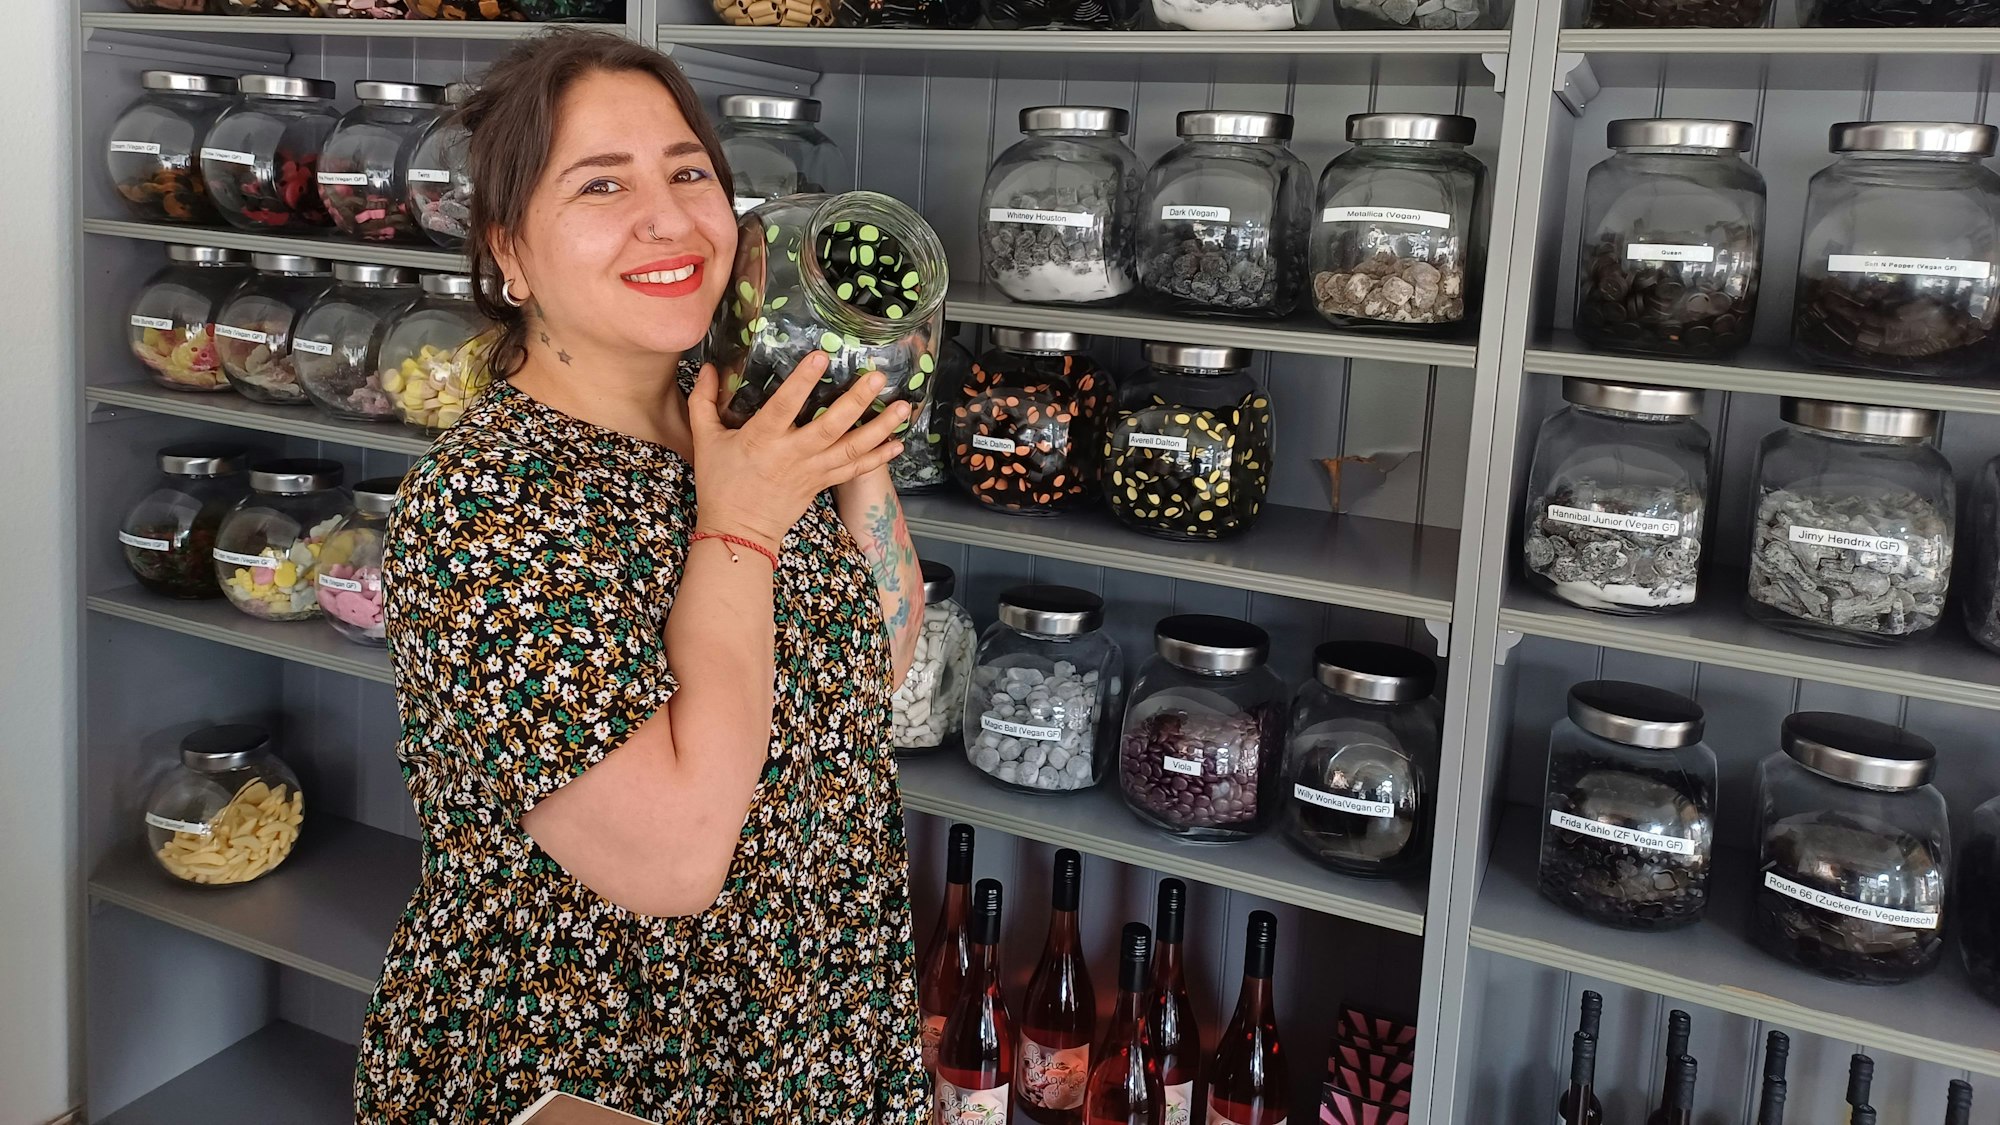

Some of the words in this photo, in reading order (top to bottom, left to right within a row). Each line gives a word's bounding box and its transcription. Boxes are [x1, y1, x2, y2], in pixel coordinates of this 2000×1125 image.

[1007, 211, 1034, 220] Whitney
[1036, 212, 1067, 222] Houston
[1169, 208, 1186, 216] Dark
[1188, 209, 1219, 218] (Vegan)
[1346, 210, 1383, 218] Metallica
[1386, 211, 1421, 221] (Vegan)
[232, 329, 250, 338] (Vegan
[251, 333, 263, 341] GF)
[974, 437, 988, 447] Jack
[990, 439, 1012, 450] Dalton
[1131, 435, 1154, 445] Averell
[1155, 437, 1180, 448] Dalton
[1552, 508, 1591, 522] Hannibal
[1593, 515, 1622, 526] Junior
[1625, 519, 1659, 531] (Vegan
[1798, 530, 1824, 543] Jimy
[1827, 533, 1871, 548] Hendrix
[1875, 540, 1900, 552] (GF)
[346, 582, 357, 590] GF)
[984, 719, 1003, 731] Magic
[1004, 724, 1017, 733] Ball
[1019, 727, 1045, 737] (Vegan
[1047, 730, 1060, 738] GF)
[1172, 760, 1192, 771] Viola
[1297, 787, 1314, 800] Willy
[1375, 804, 1391, 814] GF)
[1560, 815, 1582, 829] Frida
[1585, 822, 1610, 836] Kahlo
[1613, 829, 1631, 840] (ZF
[1633, 834, 1664, 848] Vegan
[1666, 839, 1684, 851] GF)
[1769, 876, 1797, 895] Route
[1799, 888, 1813, 900] 66
[1815, 894, 1872, 917] (Zuckerfrei
[1875, 909, 1935, 926] Vegetarisch)
